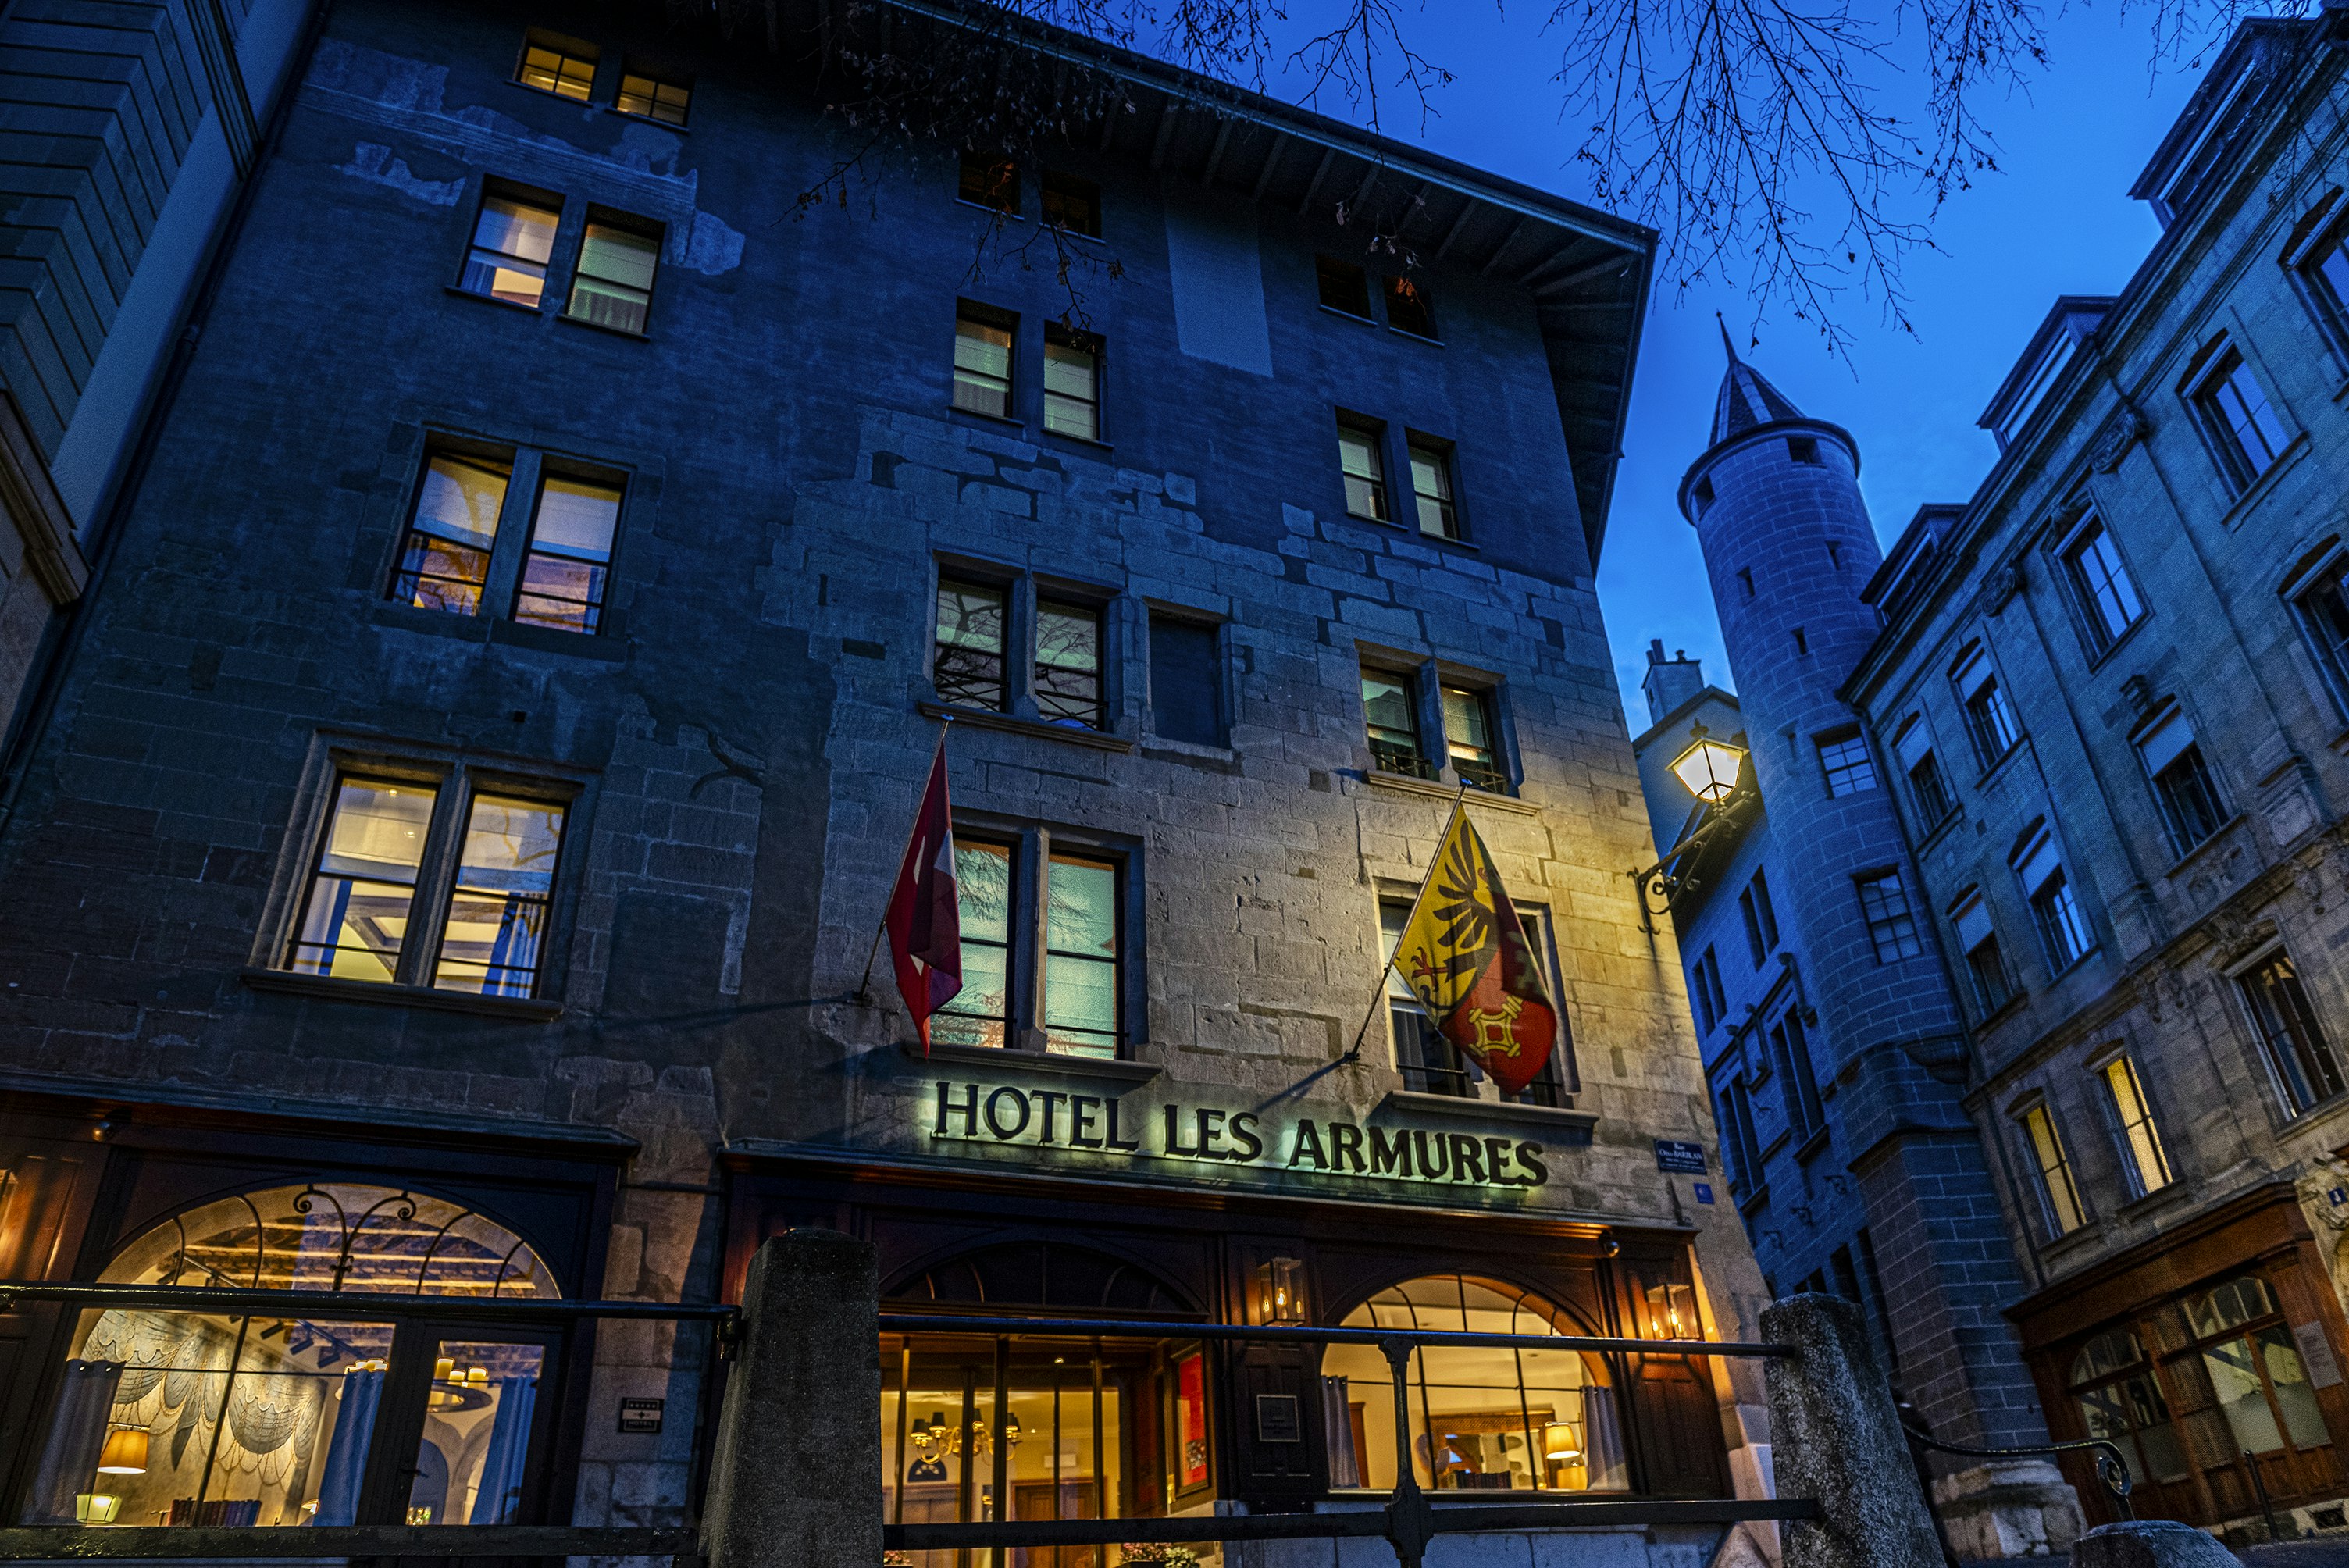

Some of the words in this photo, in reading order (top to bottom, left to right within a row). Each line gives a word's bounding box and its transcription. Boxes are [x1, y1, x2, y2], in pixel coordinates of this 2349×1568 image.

[935, 1082, 1139, 1151] HOTEL
[1164, 1104, 1263, 1162] LES
[1286, 1119, 1548, 1187] ARMURES
